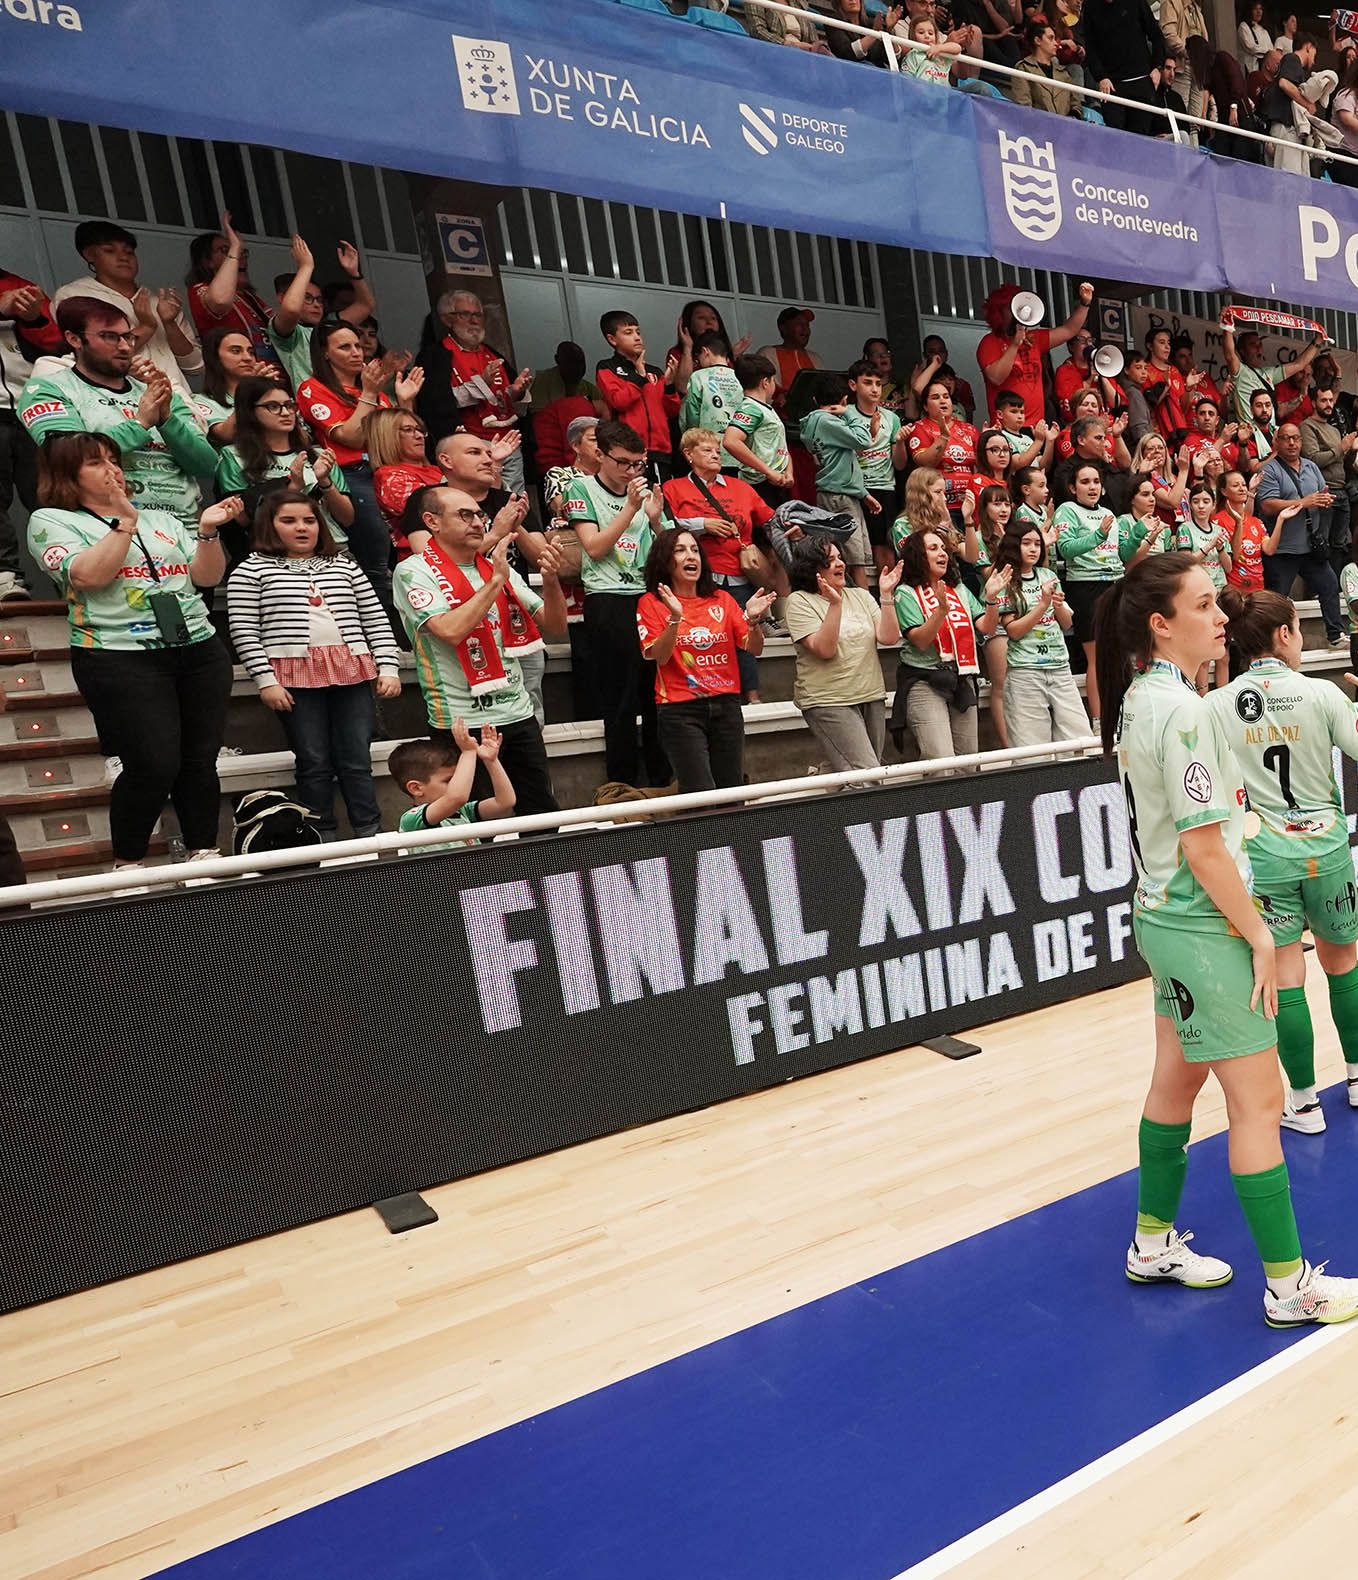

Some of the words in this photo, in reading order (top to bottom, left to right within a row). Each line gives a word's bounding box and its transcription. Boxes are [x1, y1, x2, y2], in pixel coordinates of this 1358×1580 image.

[524, 54, 641, 105] XUNTA
[529, 87, 575, 121] DE
[584, 100, 712, 149] GALICIA
[782, 112, 848, 138] DEPORTE
[785, 131, 845, 154] GALEGO
[1071, 177, 1149, 209] Concello
[1075, 203, 1099, 224] de
[1101, 207, 1199, 242] Pontevedra
[448, 229, 480, 259] C
[22, 401, 65, 422] FROIZ
[696, 653, 728, 666] ence
[1266, 696, 1303, 705] CONCELLO
[1267, 704, 1277, 712] DE
[1276, 703, 1295, 712] POIO
[1281, 725, 1301, 741] PAZ
[1263, 744, 1300, 809] 7
[459, 836, 829, 1034] FINAL
[844, 801, 1017, 949] XIX
[1030, 783, 1136, 902] CO
[726, 930, 1024, 1067] FEMININA
[1032, 910, 1098, 984] DE
[1107, 902, 1134, 963] F
